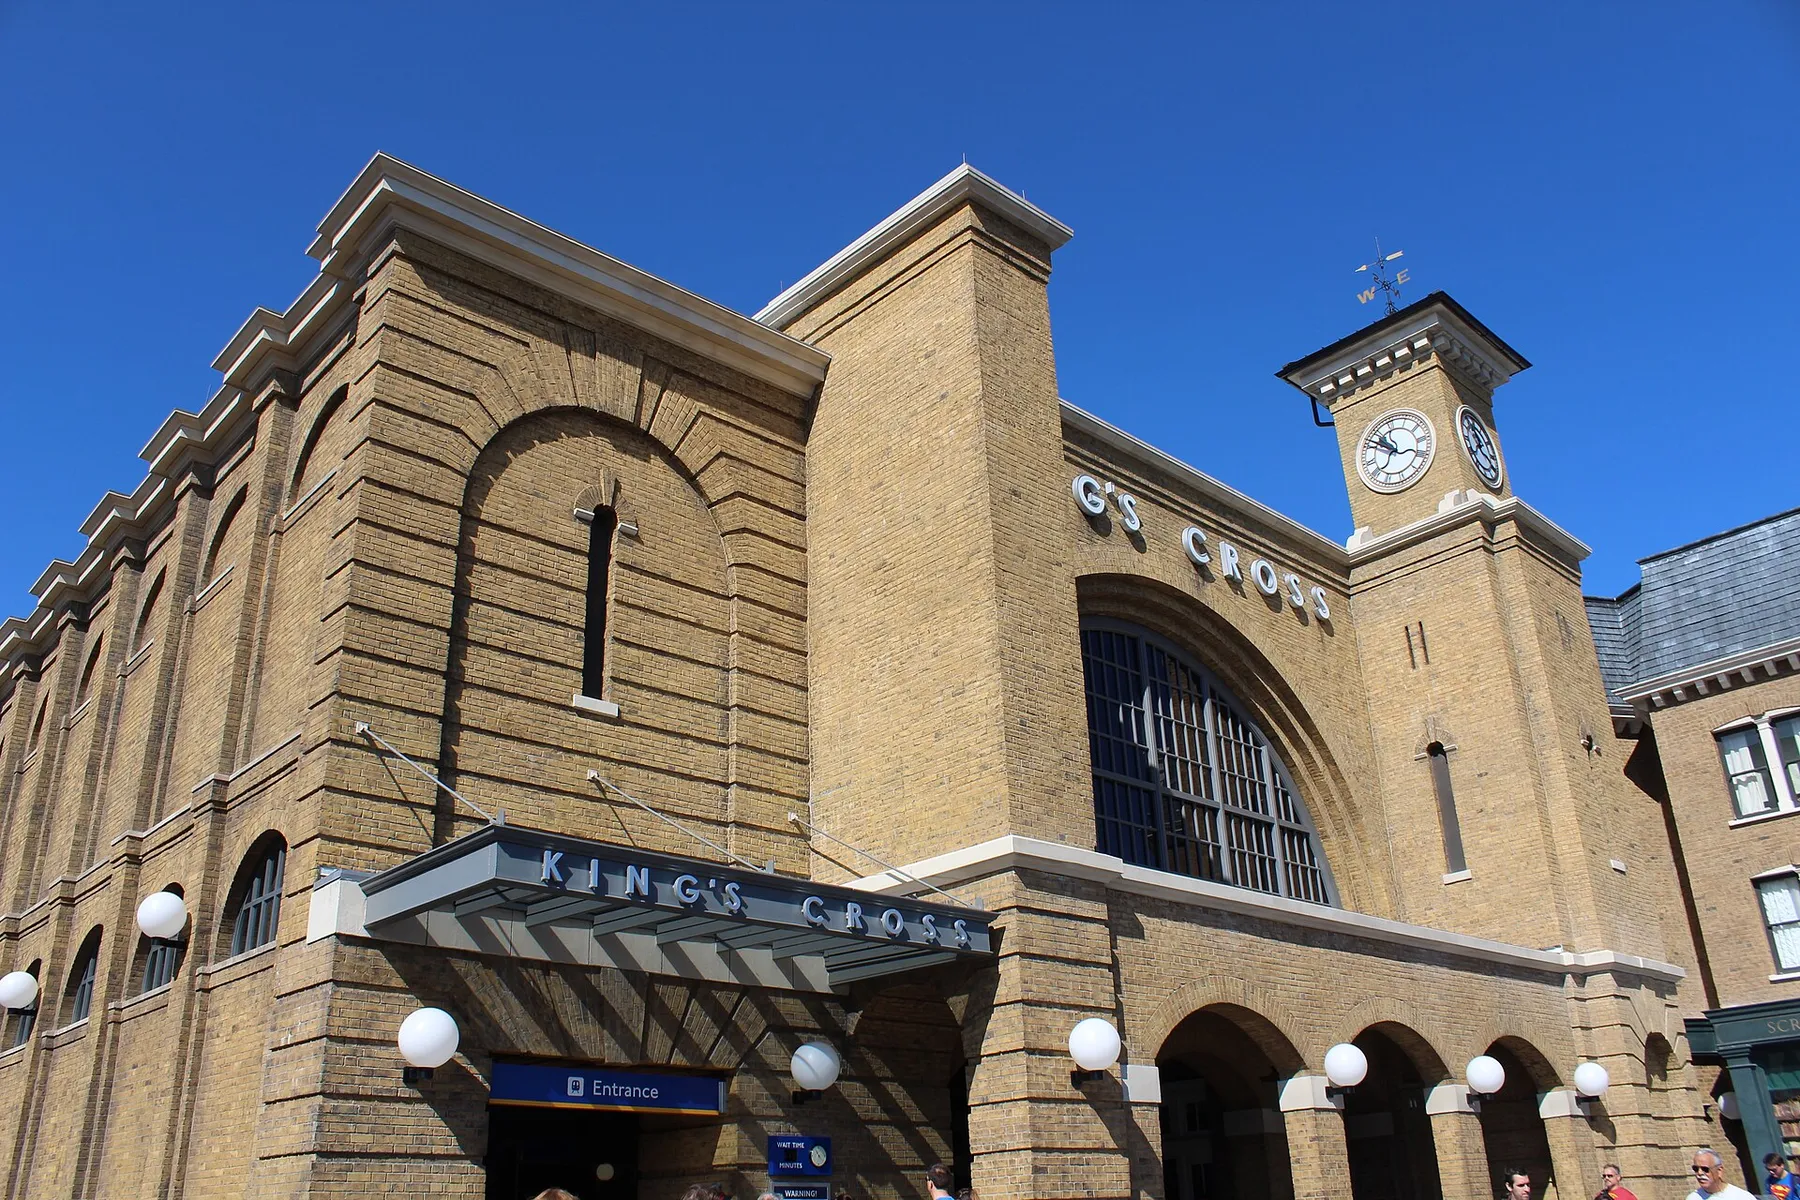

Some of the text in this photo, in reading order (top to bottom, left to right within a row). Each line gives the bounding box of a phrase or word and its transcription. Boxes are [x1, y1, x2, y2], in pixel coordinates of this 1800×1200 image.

[1396, 268, 1411, 285] E
[1356, 286, 1376, 304] W
[1181, 525, 1330, 621] CROSS
[540, 850, 971, 946] KING'S CROSS
[1767, 1018, 1800, 1034] SCR
[593, 1080, 659, 1099] Entrance
[776, 1141, 791, 1149] WAIT
[784, 1189, 818, 1197] WARNING!
